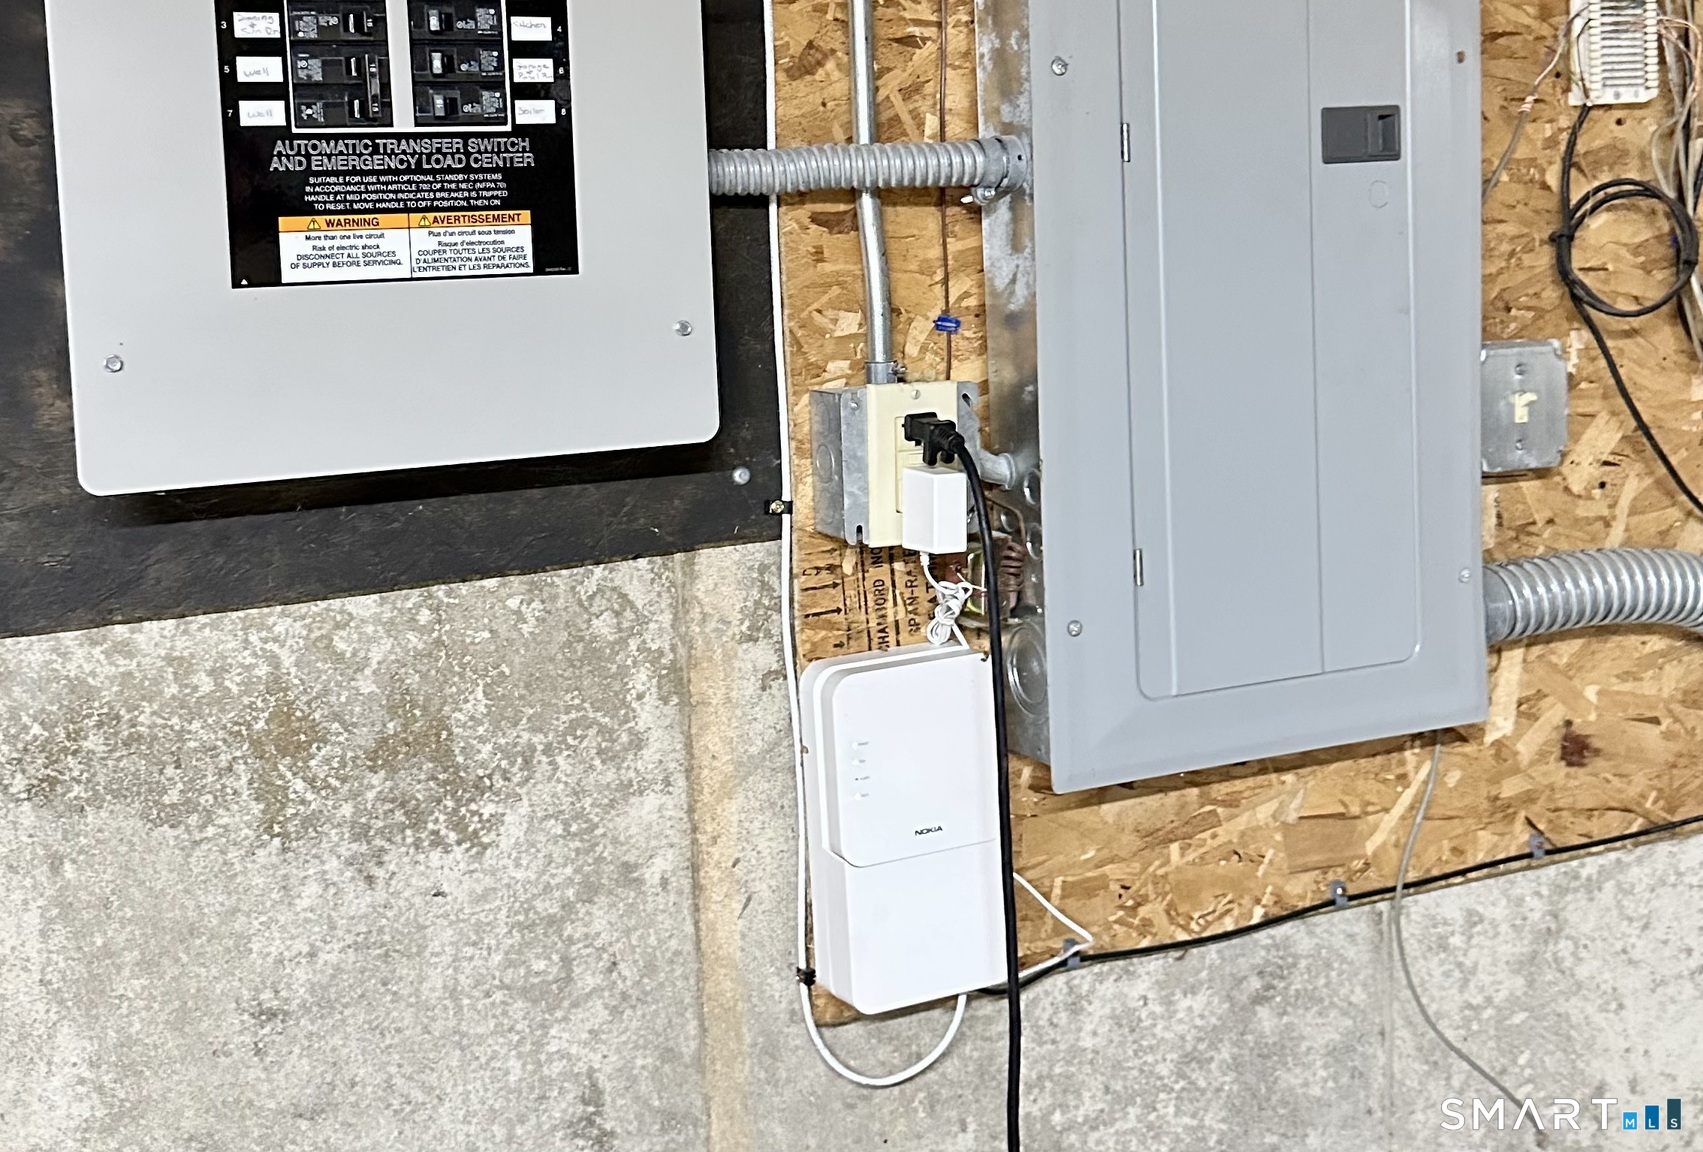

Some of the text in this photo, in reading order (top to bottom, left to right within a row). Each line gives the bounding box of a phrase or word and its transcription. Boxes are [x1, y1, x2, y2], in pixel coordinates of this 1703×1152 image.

[273, 138, 530, 155] AUTOMATIC TRANSFER SWITCH
[270, 153, 535, 171] AND EMERGENCY LOAD CENTER
[325, 218, 379, 227] WARNING
[432, 213, 521, 224] AVERTISSEMENT
[297, 253, 344, 261] DISCONNECT
[915, 826, 943, 836] NOKIA
